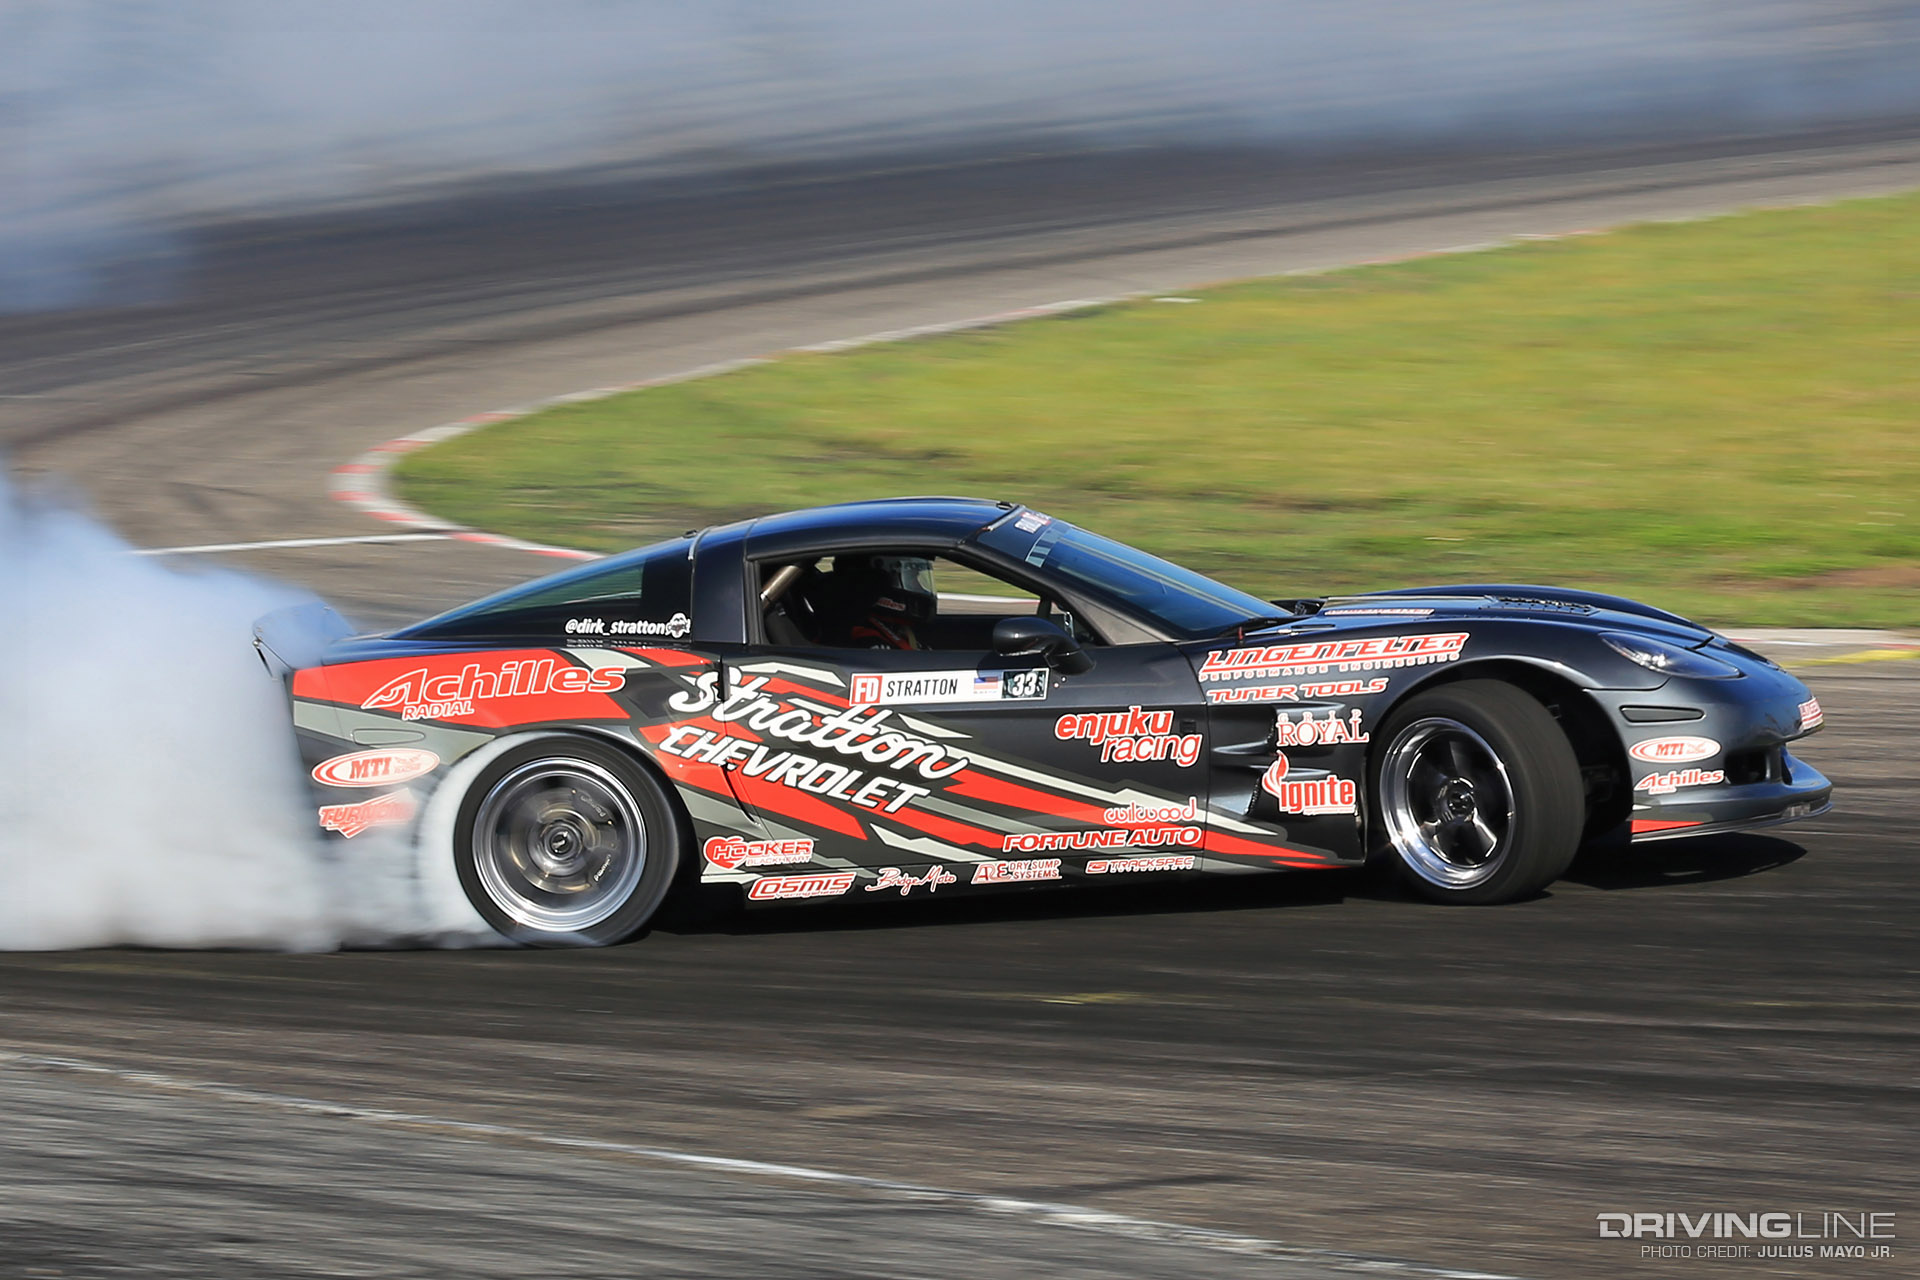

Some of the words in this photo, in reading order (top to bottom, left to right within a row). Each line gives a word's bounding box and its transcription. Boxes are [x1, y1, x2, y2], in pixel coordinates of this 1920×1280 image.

[1207, 633, 1469, 666] LINGENFELTER
[1200, 664, 1329, 682] PERFORMANCE
[1340, 652, 1461, 671] ENGINEERING
[361, 658, 627, 709] Achilles
[855, 676, 880, 702] FD
[886, 678, 958, 697] STRATTON
[1012, 673, 1038, 696] 33
[1207, 685, 1298, 702] TUNER
[1301, 678, 1389, 698] TOOLS
[402, 700, 475, 721] RADIAL
[669, 667, 968, 778] Stratton
[1055, 706, 1173, 746] enjuku
[1277, 719, 1369, 746] ROYAL
[1101, 734, 1202, 767] racing
[1656, 743, 1684, 756] MTI
[349, 757, 392, 779] MTI
[659, 725, 931, 813] CHEVROLET
[1636, 770, 1723, 790] Achilles
[1280, 776, 1355, 812] ignite
[1104, 797, 1197, 824] wilwood
[713, 840, 813, 861] HOOKER
[1003, 830, 1128, 852] FORTUNE
[1127, 827, 1202, 848] AUTO
[1009, 862, 1030, 872] DRY
[1031, 859, 1061, 870] SUMP
[1013, 869, 1059, 880] SYSTEMS
[1109, 857, 1194, 868] TRACKSPEC
[749, 873, 855, 899] COSMIS
